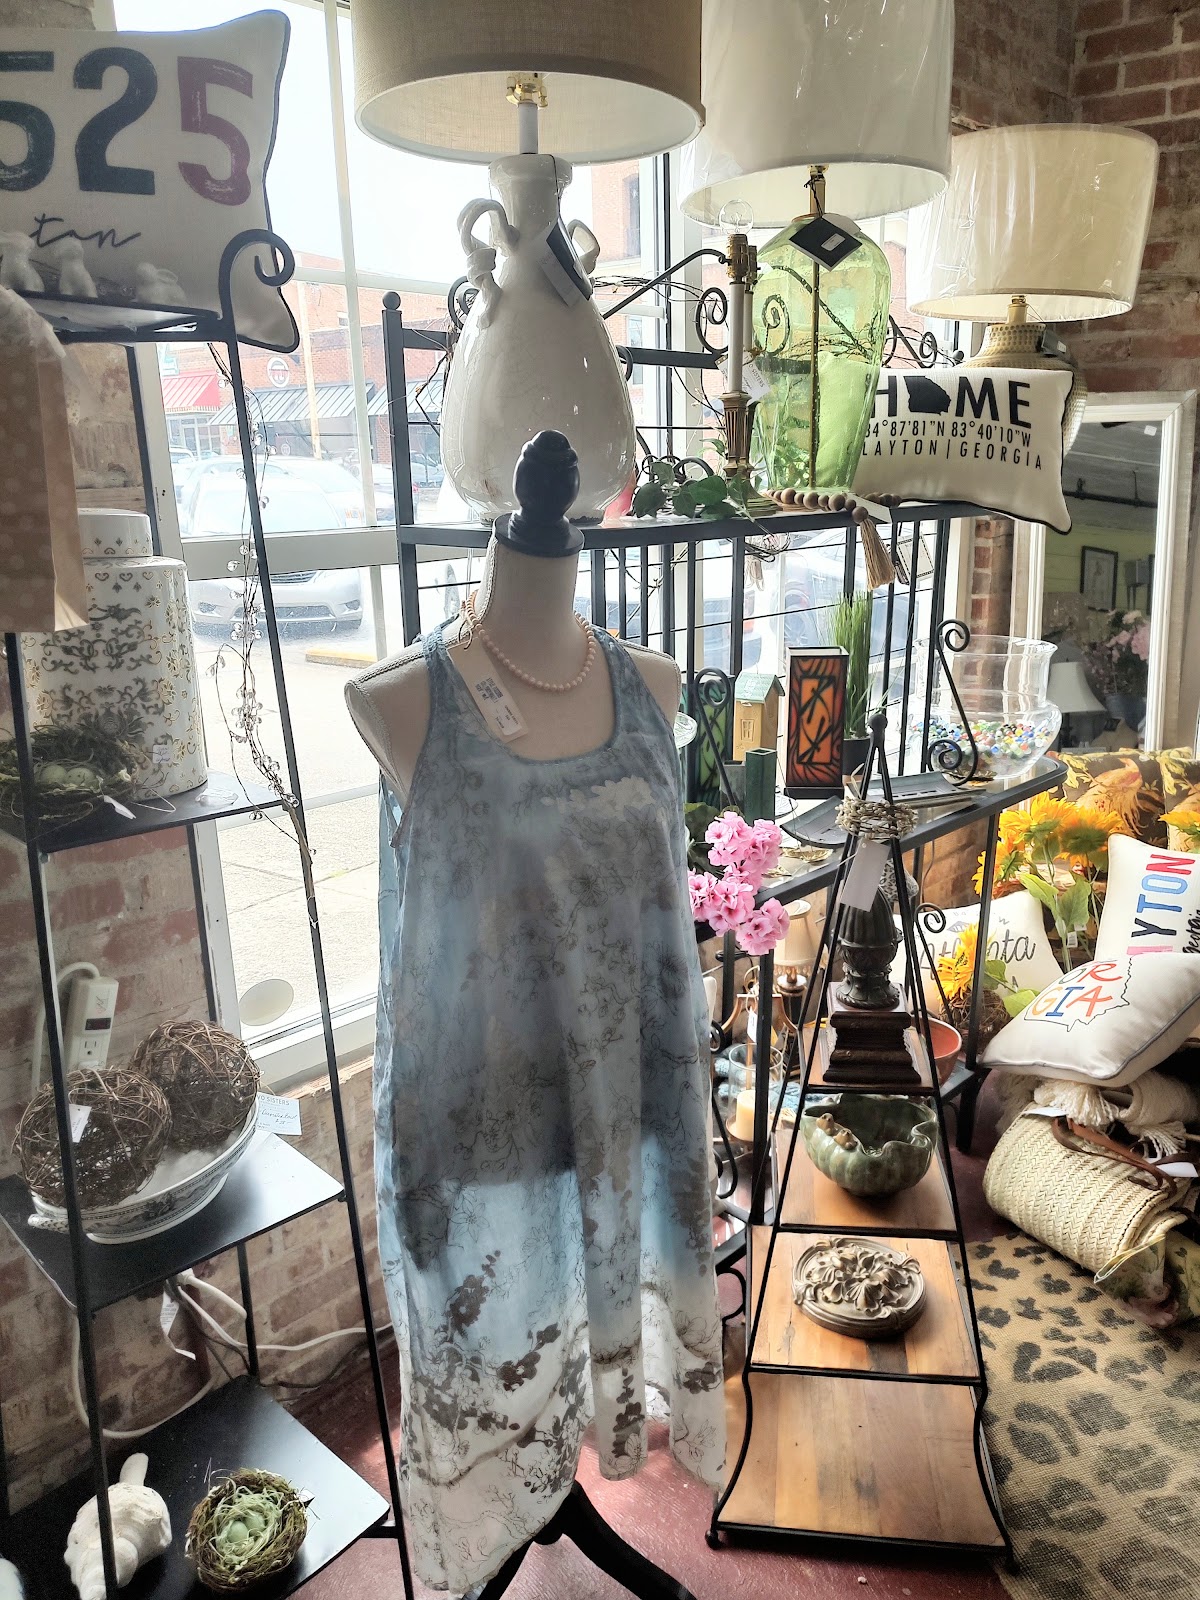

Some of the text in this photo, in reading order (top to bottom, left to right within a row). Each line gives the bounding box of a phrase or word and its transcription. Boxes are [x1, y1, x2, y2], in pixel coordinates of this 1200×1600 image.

[960, 442, 1042, 470] GEORGIA
[1031, 985, 1114, 1018] GIA
[266, 1096, 290, 1105] SISTERS
